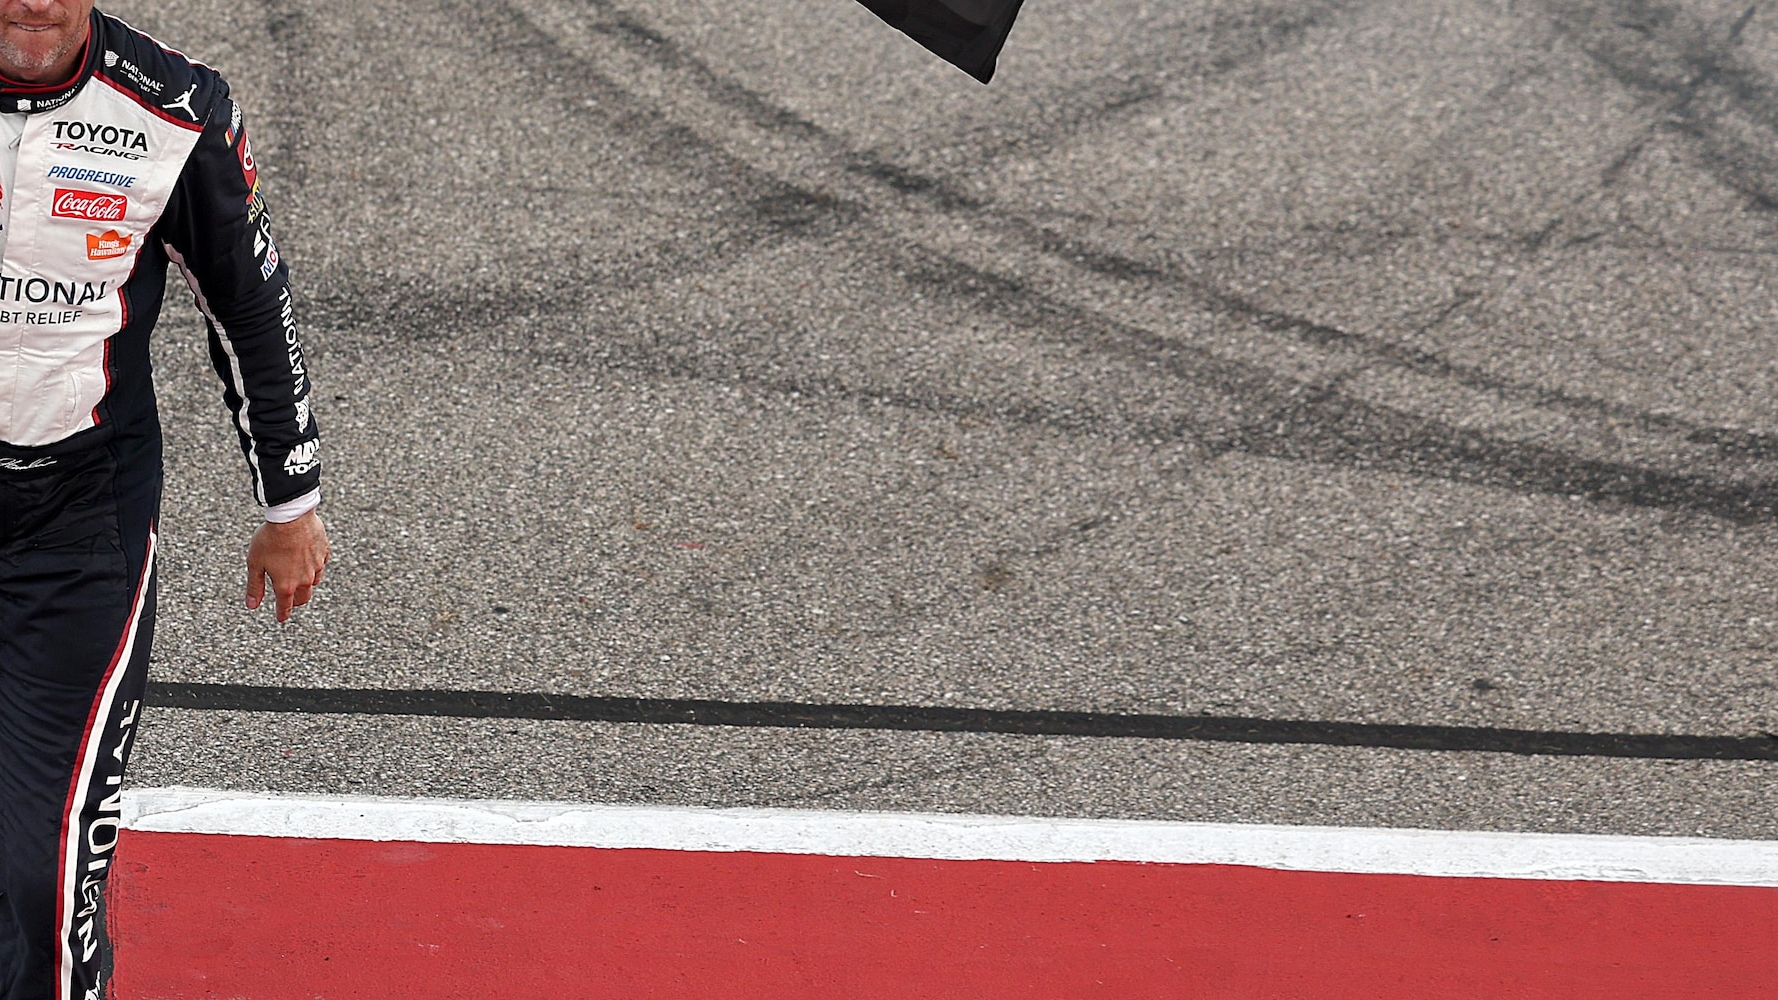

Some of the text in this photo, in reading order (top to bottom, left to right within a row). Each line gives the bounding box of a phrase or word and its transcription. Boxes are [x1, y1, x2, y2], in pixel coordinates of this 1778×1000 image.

[53, 121, 149, 152] TOYOTA
[50, 142, 148, 161] RACING
[47, 165, 137, 188] PROGRESSIVE
[54, 192, 126, 220] Coca-Cola
[90, 246, 126, 257] Hawaiian
[98, 239, 121, 250] King's
[26, 309, 83, 326] RELIEF
